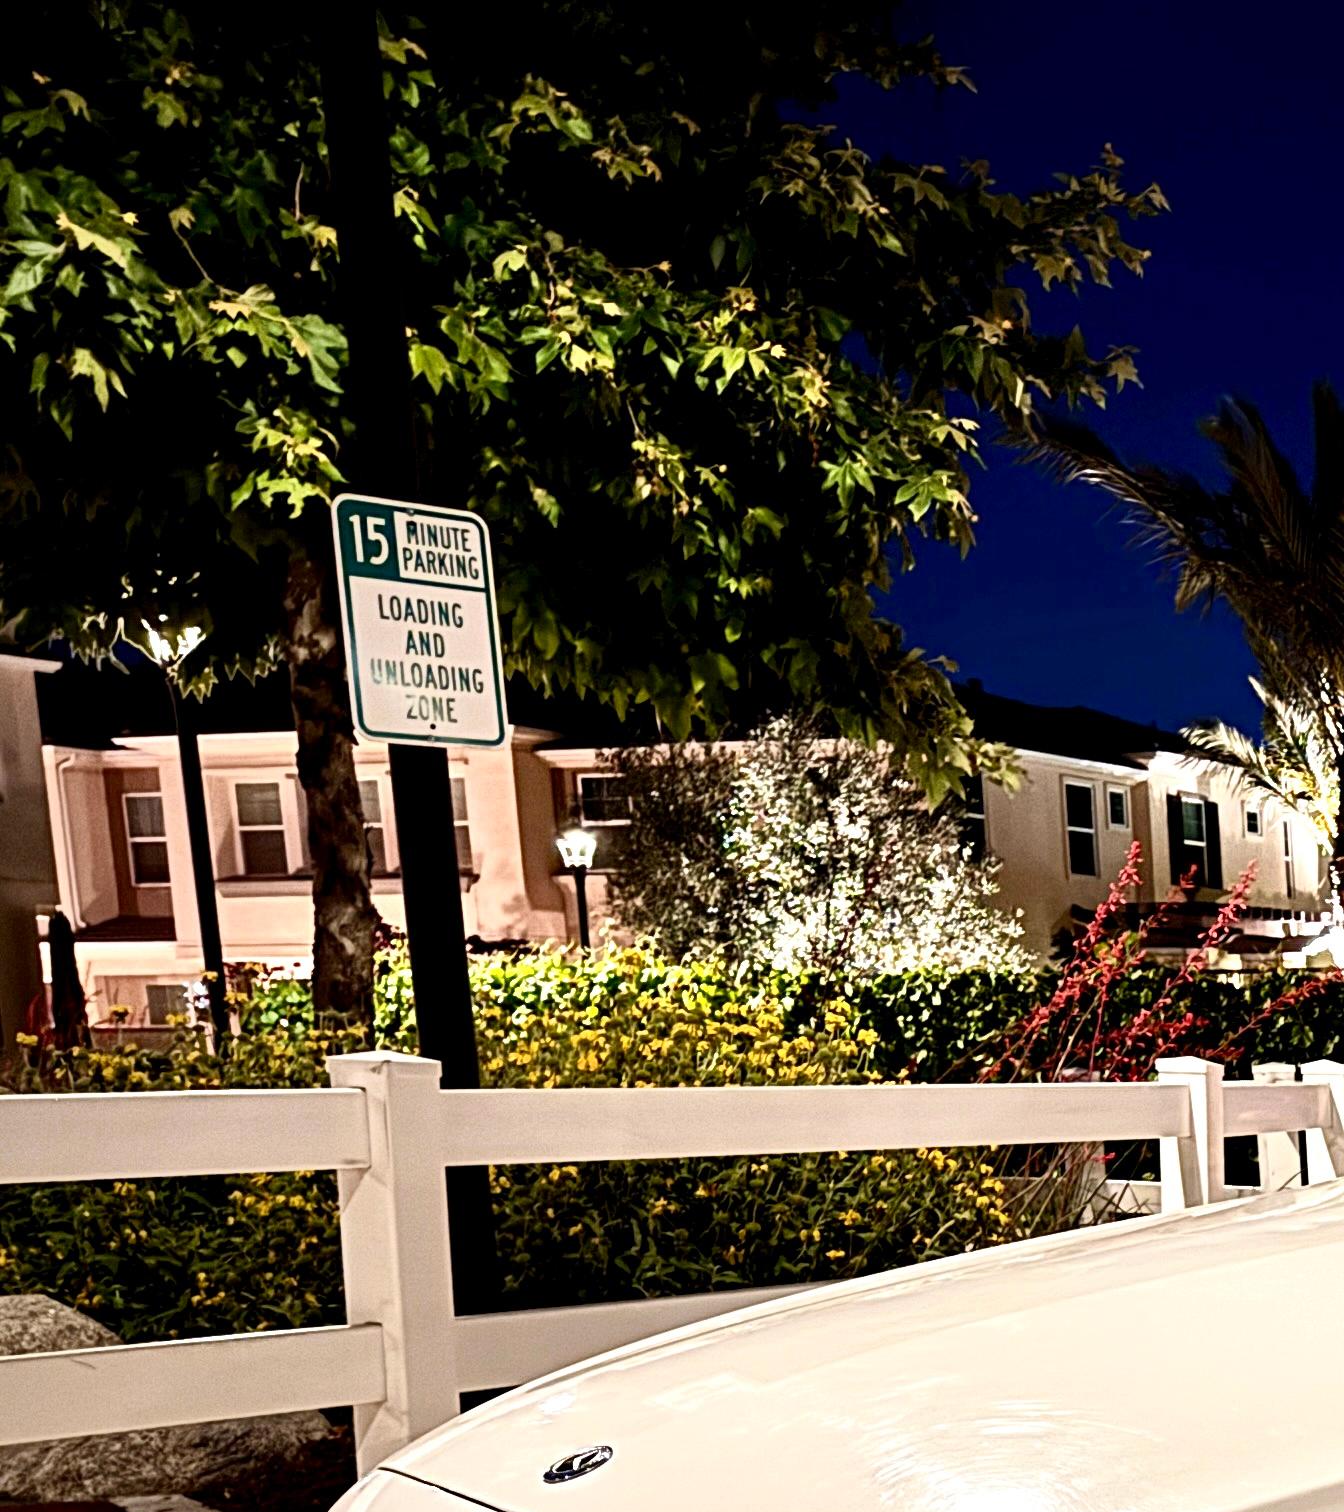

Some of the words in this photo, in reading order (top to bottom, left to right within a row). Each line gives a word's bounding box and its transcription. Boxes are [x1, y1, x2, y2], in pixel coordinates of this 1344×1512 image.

[349, 514, 390, 566] 15
[406, 521, 472, 552] MINUTE
[402, 547, 480, 580] PARKING
[377, 594, 464, 628] LOADING
[405, 630, 446, 658] AND
[370, 658, 484, 694] UNLOADING
[405, 694, 458, 724] ZONE
